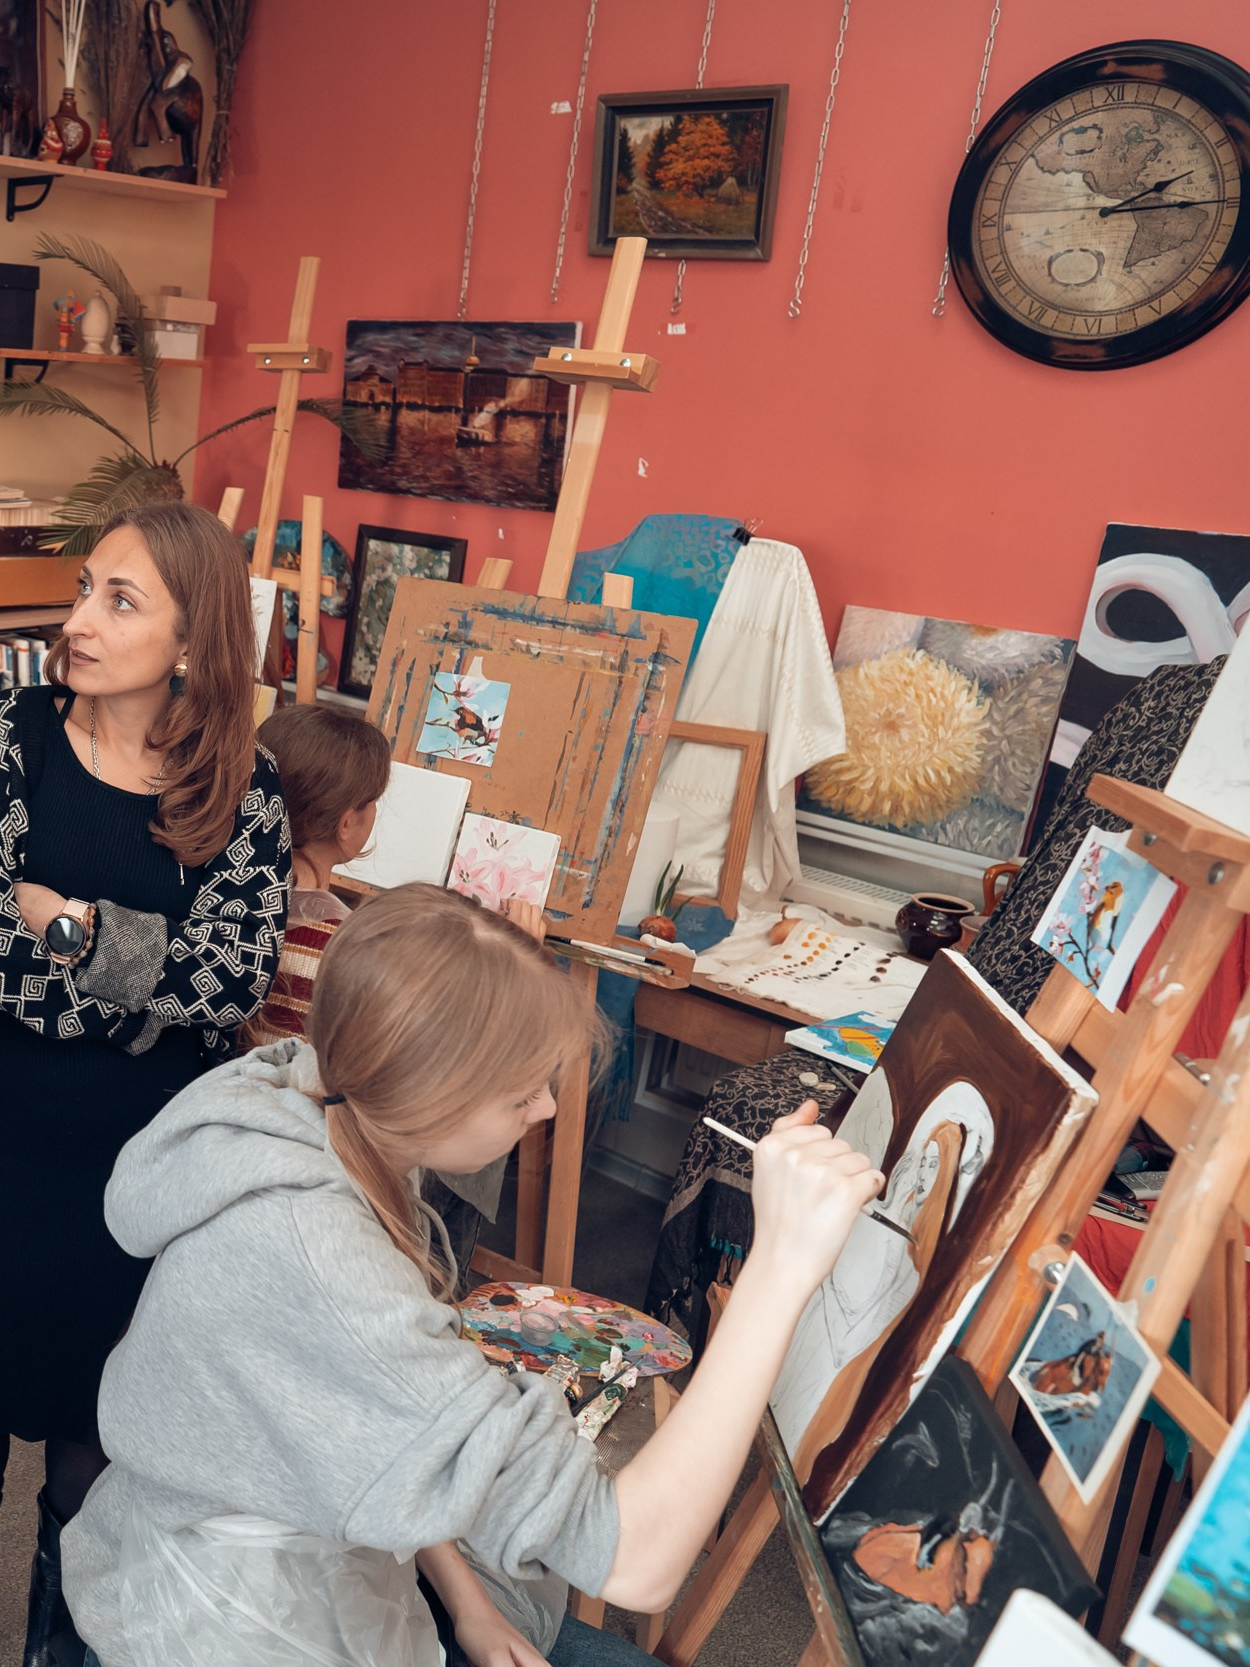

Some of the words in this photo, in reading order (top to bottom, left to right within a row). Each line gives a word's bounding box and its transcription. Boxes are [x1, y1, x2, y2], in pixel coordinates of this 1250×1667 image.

[1103, 85, 1125, 103] XII
[1042, 108, 1063, 129] XI
[1000, 156, 1017, 172] X
[982, 213, 997, 228] IX
[1198, 251, 1218, 273] IV
[991, 260, 1012, 287] VIII
[1028, 301, 1048, 321] VII
[1148, 299, 1162, 316] V
[1084, 318, 1102, 334] VI
